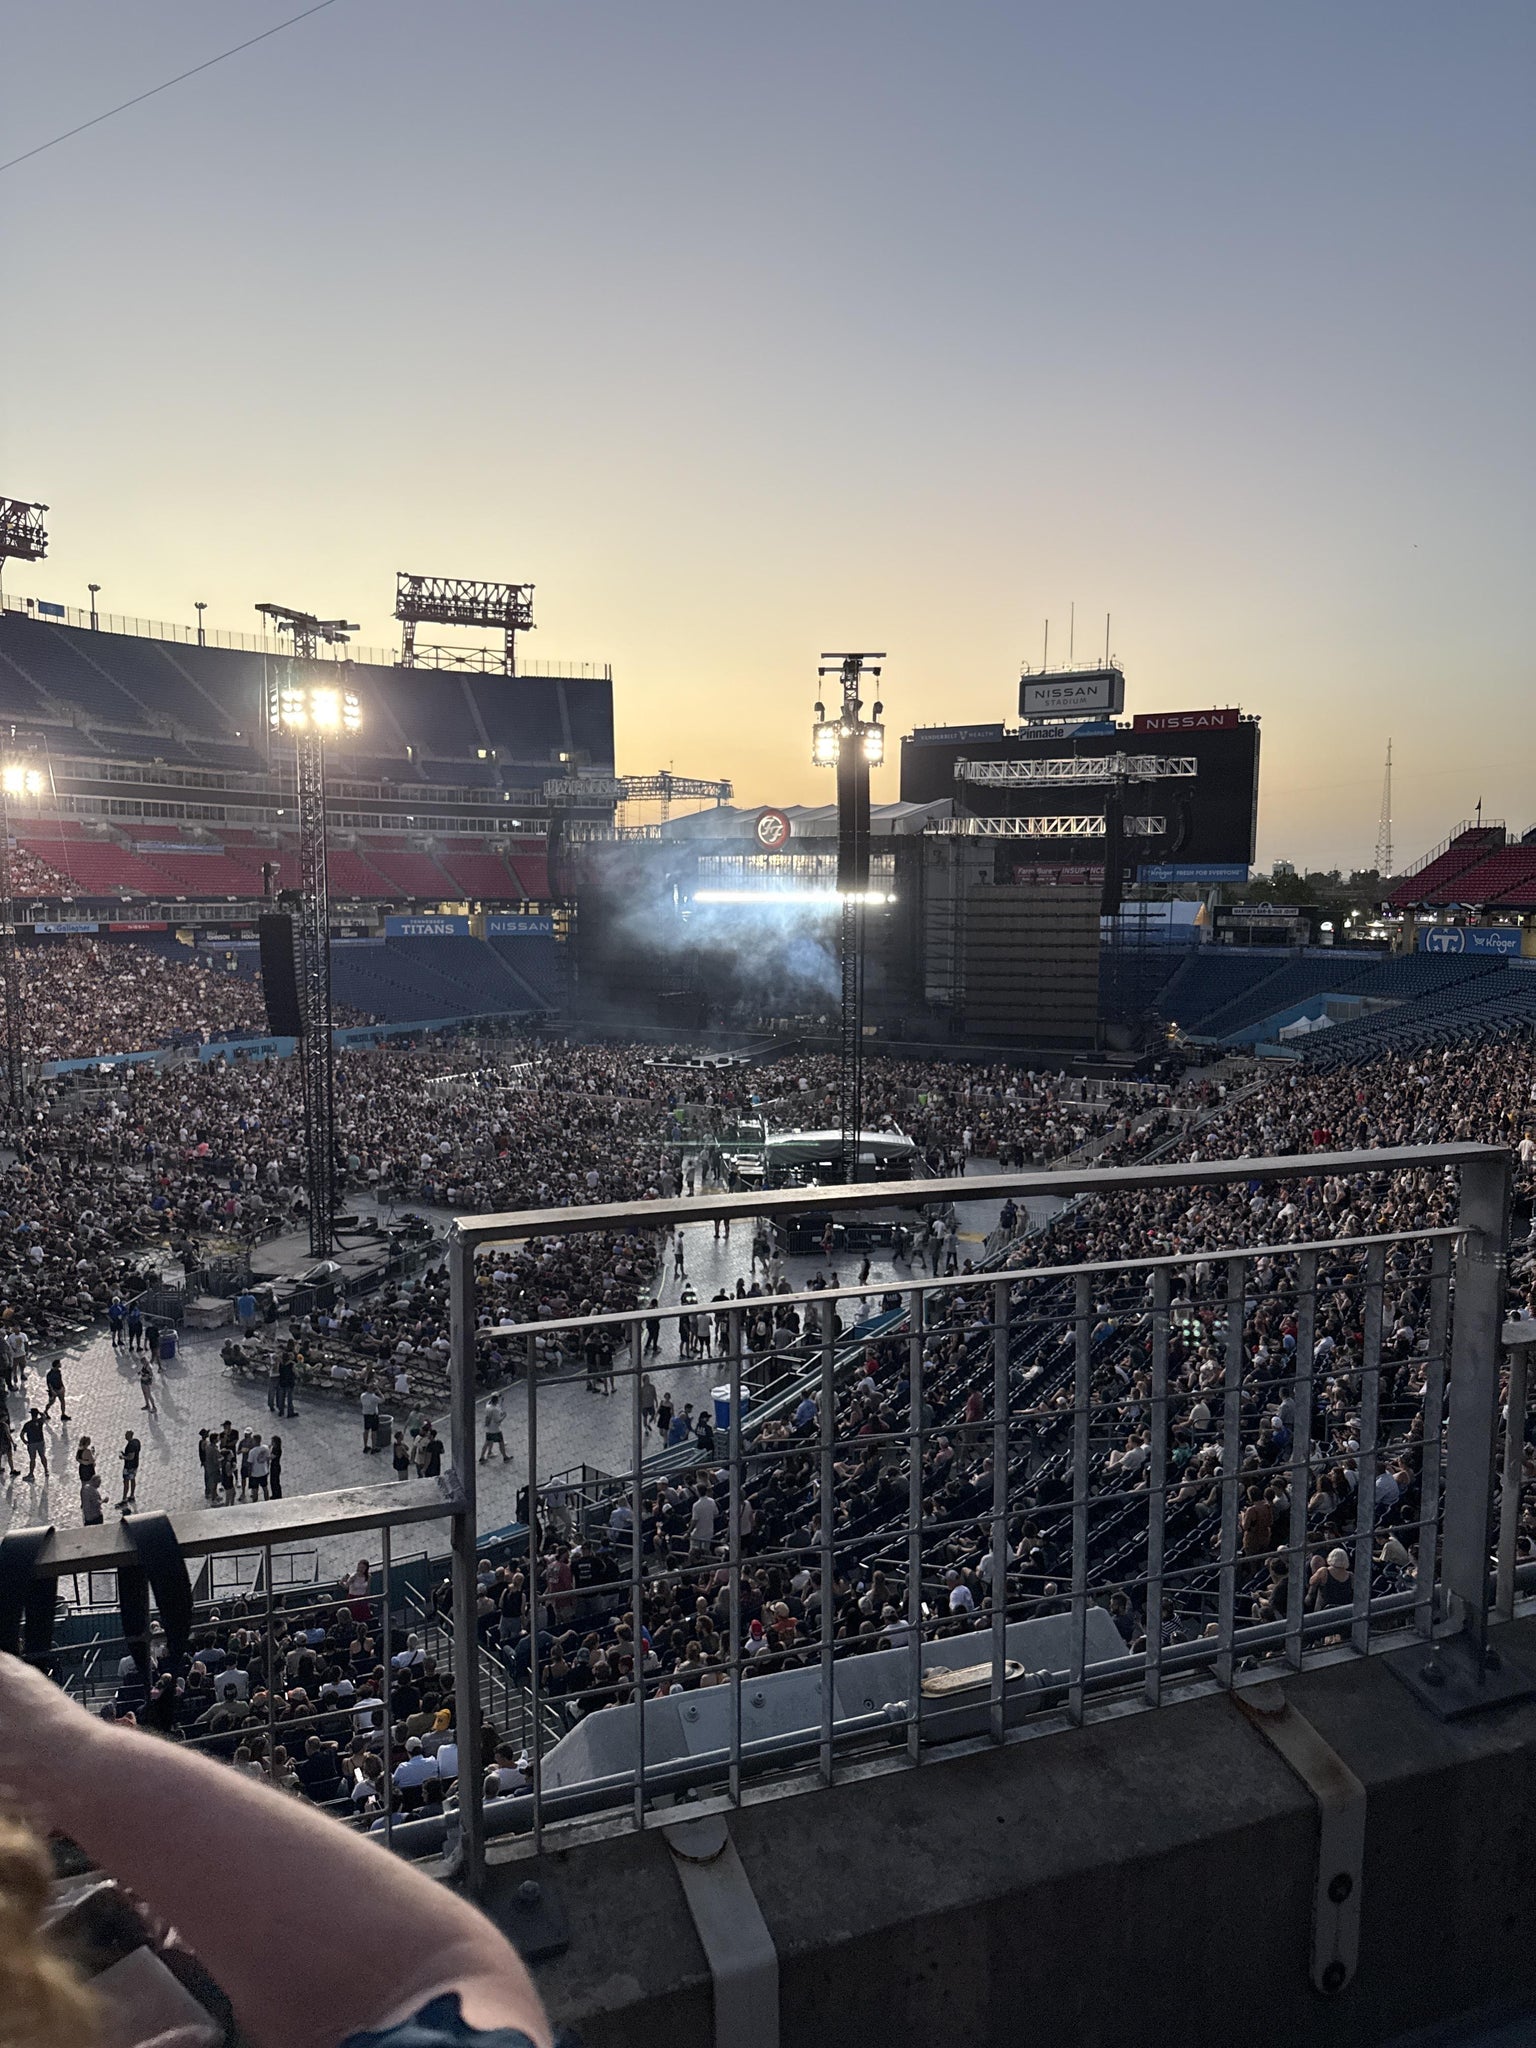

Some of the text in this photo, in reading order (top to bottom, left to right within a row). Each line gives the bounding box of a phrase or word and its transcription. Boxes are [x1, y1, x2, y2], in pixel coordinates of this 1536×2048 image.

[1035, 686, 1098, 699] NISSAN
[1044, 698, 1087, 706] STADIUM
[1146, 715, 1224, 729] NISSAN
[920, 733, 958, 741] VANDERBILT
[1020, 726, 1064, 740] Pinnacle
[1150, 866, 1173, 880] Kroger
[56, 923, 90, 932] Gallagher
[401, 924, 454, 935] TITANS
[490, 922, 549, 931] NISSAN
[1485, 932, 1517, 954] Kroger
